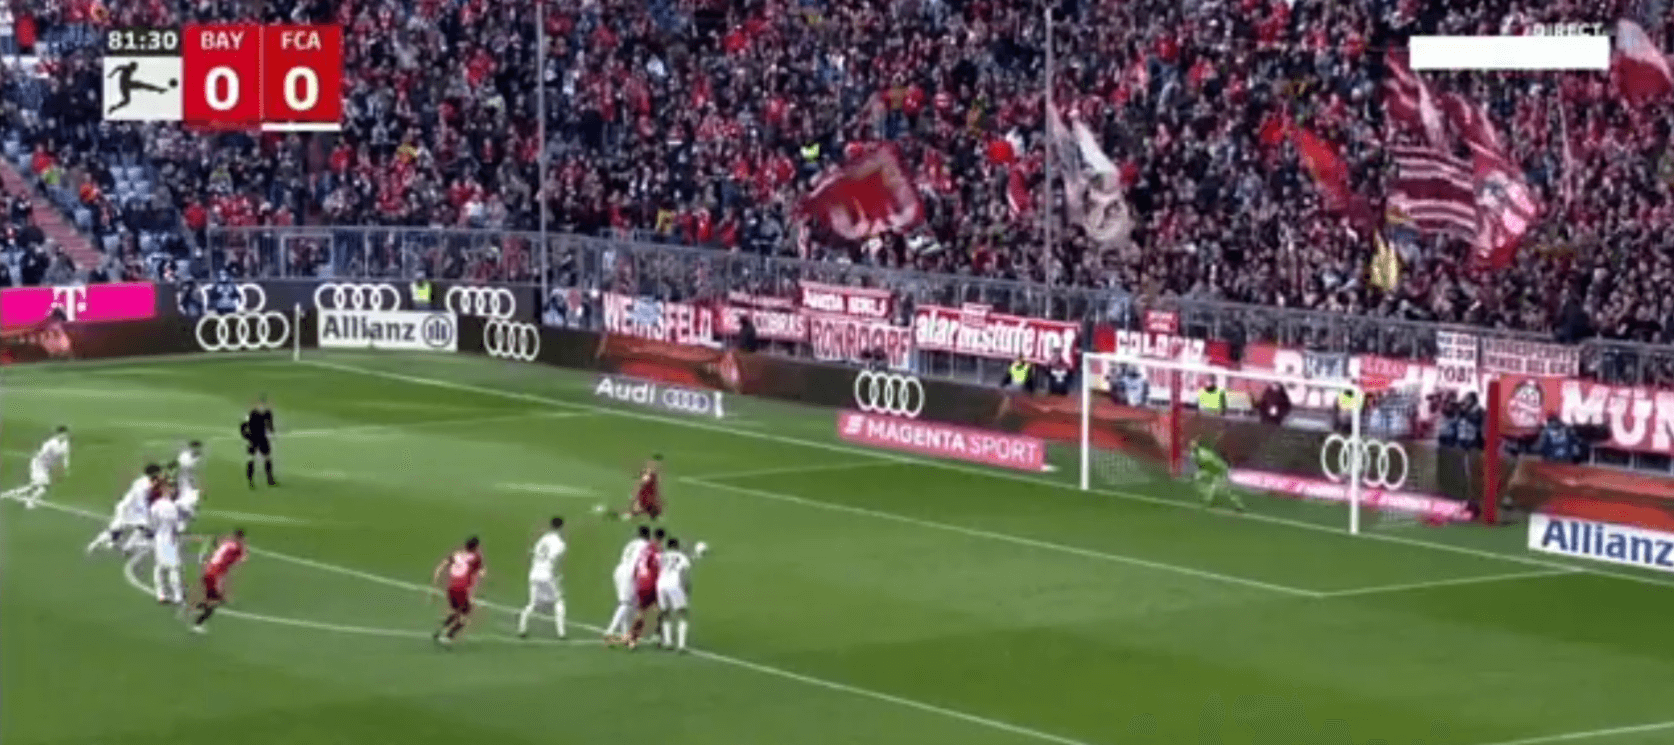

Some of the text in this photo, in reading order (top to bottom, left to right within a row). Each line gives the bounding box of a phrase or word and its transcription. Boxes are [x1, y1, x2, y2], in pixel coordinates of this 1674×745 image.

[321, 314, 416, 343] Allianz
[603, 291, 722, 349] WESFELD
[595, 377, 655, 403] Audi
[867, 419, 1038, 463] MAGENTA SPORT
[1542, 519, 1674, 567] Allianz
